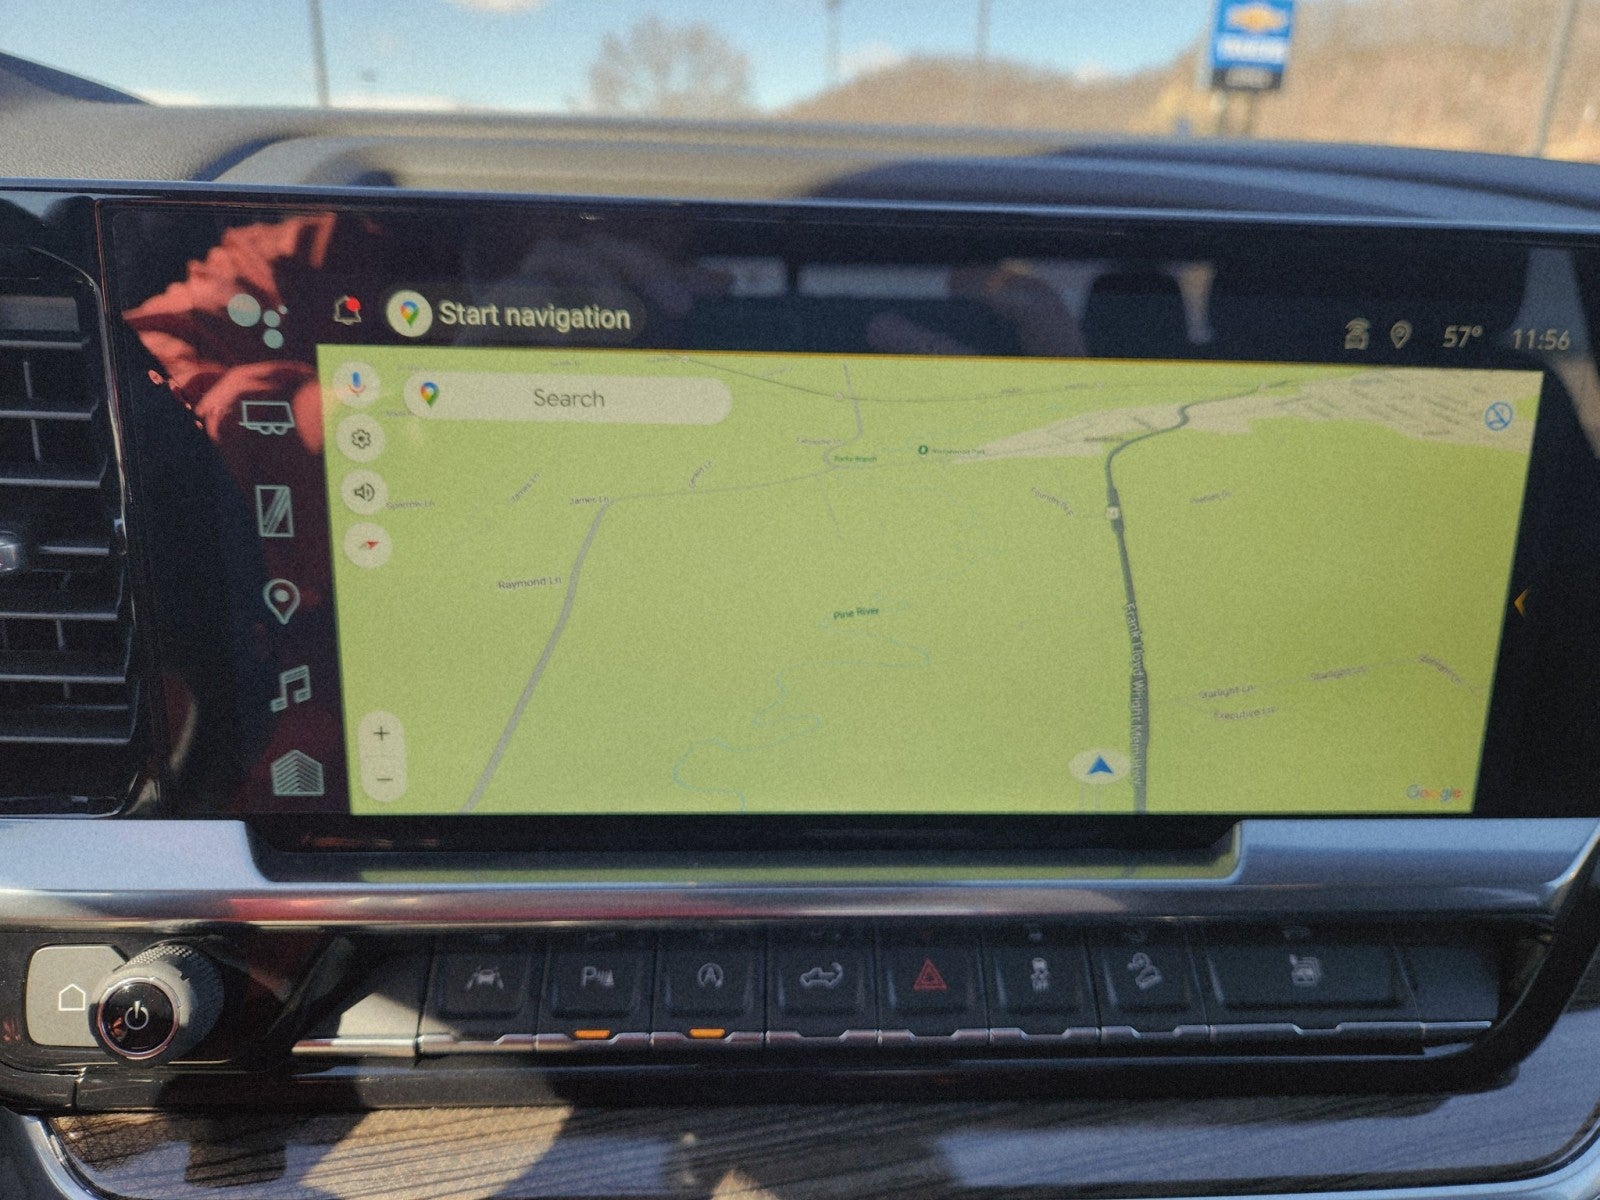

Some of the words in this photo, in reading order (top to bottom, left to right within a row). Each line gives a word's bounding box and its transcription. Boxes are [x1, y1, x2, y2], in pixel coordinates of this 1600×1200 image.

[438, 300, 500, 327] Start
[504, 303, 631, 333] navigation
[1442, 325, 1484, 348] 57°
[1512, 328, 1572, 350] 11:56
[533, 388, 606, 409] Search
[569, 495, 598, 505] James
[496, 577, 546, 590] Raymond
[548, 576, 562, 586] Ln
[832, 609, 854, 621] Pine
[856, 606, 879, 617] River
[1125, 602, 1141, 638] Frank
[1131, 641, 1144, 677] Lloyd
[1131, 679, 1145, 721] Wright
[1198, 686, 1239, 699] Starlight
[1213, 707, 1260, 720] Executive
[1406, 783, 1464, 803] Google
